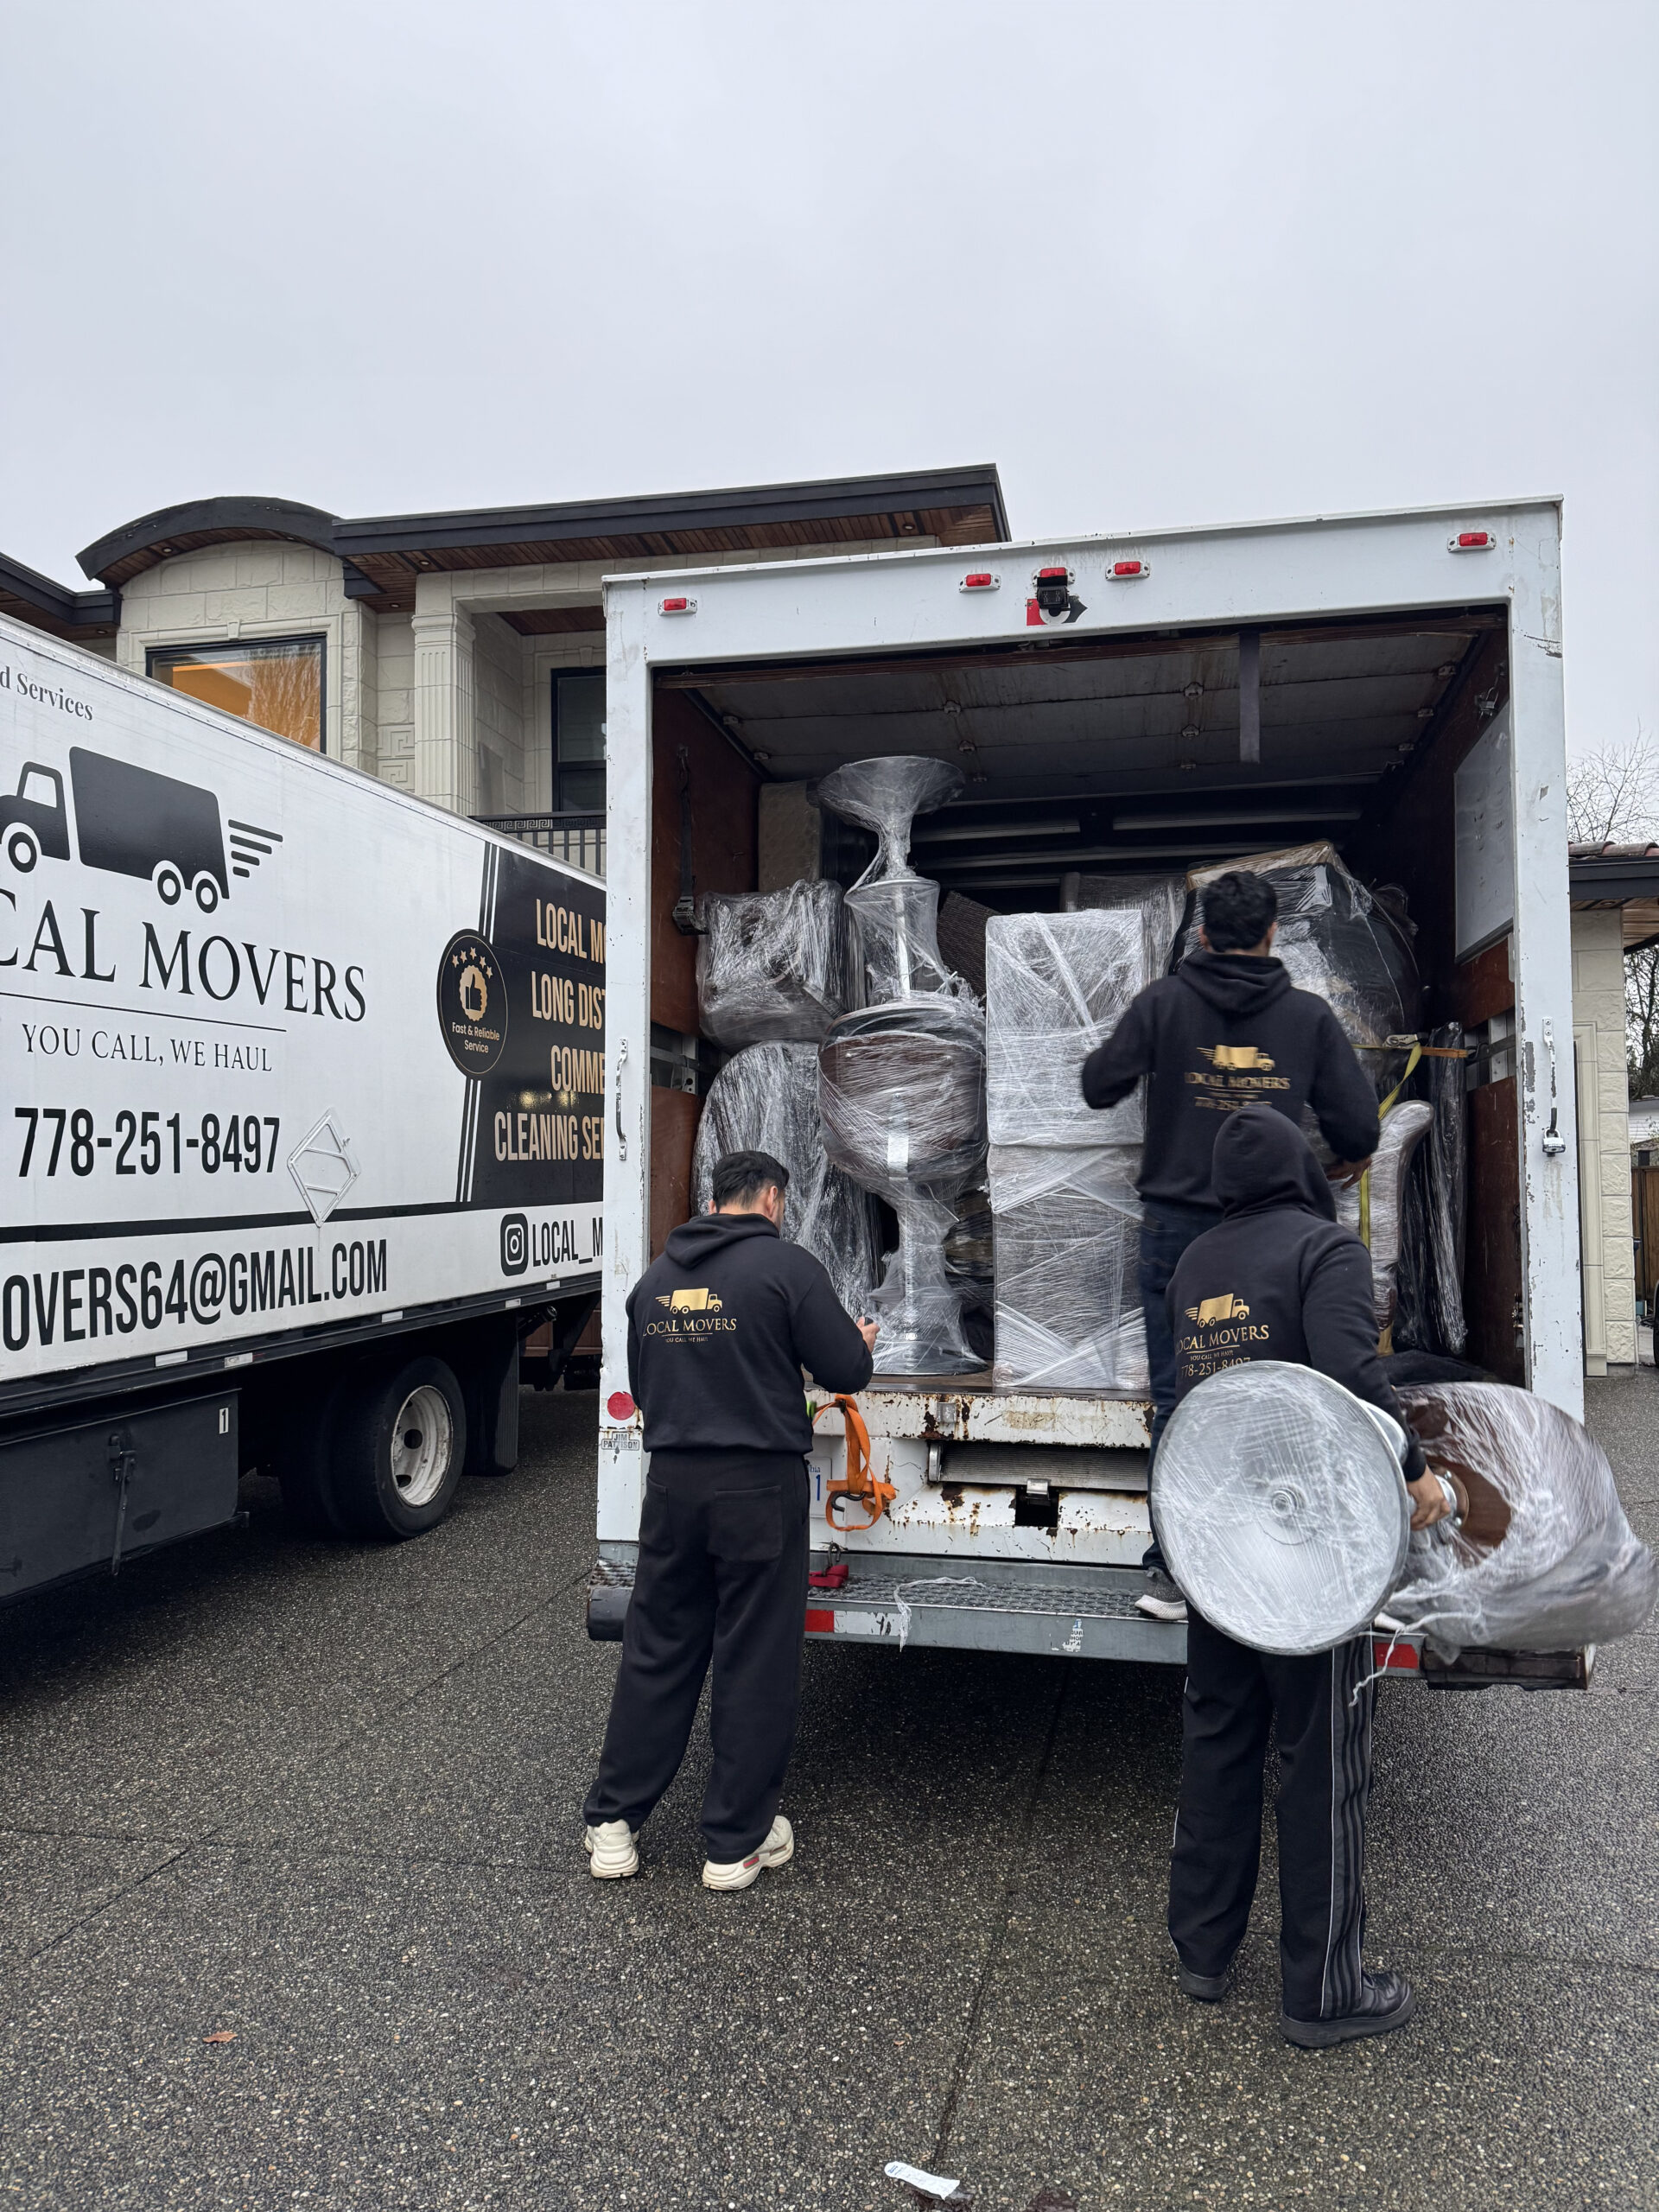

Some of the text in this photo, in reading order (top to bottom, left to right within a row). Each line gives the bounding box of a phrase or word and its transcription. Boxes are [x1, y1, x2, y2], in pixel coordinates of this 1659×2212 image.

[16, 673, 93, 721] Services
[536, 898, 607, 964] LOCAL M
[139, 921, 365, 1022] MOVERS
[531, 970, 575, 1025] LONG
[22, 1023, 272, 1071] YOU CALL, WE HAUL
[452, 1021, 500, 1041] Fast & Reliable
[464, 1039, 489, 1053] Service
[15, 1107, 280, 1177] 778-251-8497
[494, 1111, 578, 1161] CLEANING
[3, 1239, 387, 1351] OVERS64@GMAIL.COM
[683, 1318, 737, 1332] MOVERS
[1210, 1325, 1269, 1347] MOVERS
[816, 1474, 821, 1501] 1
